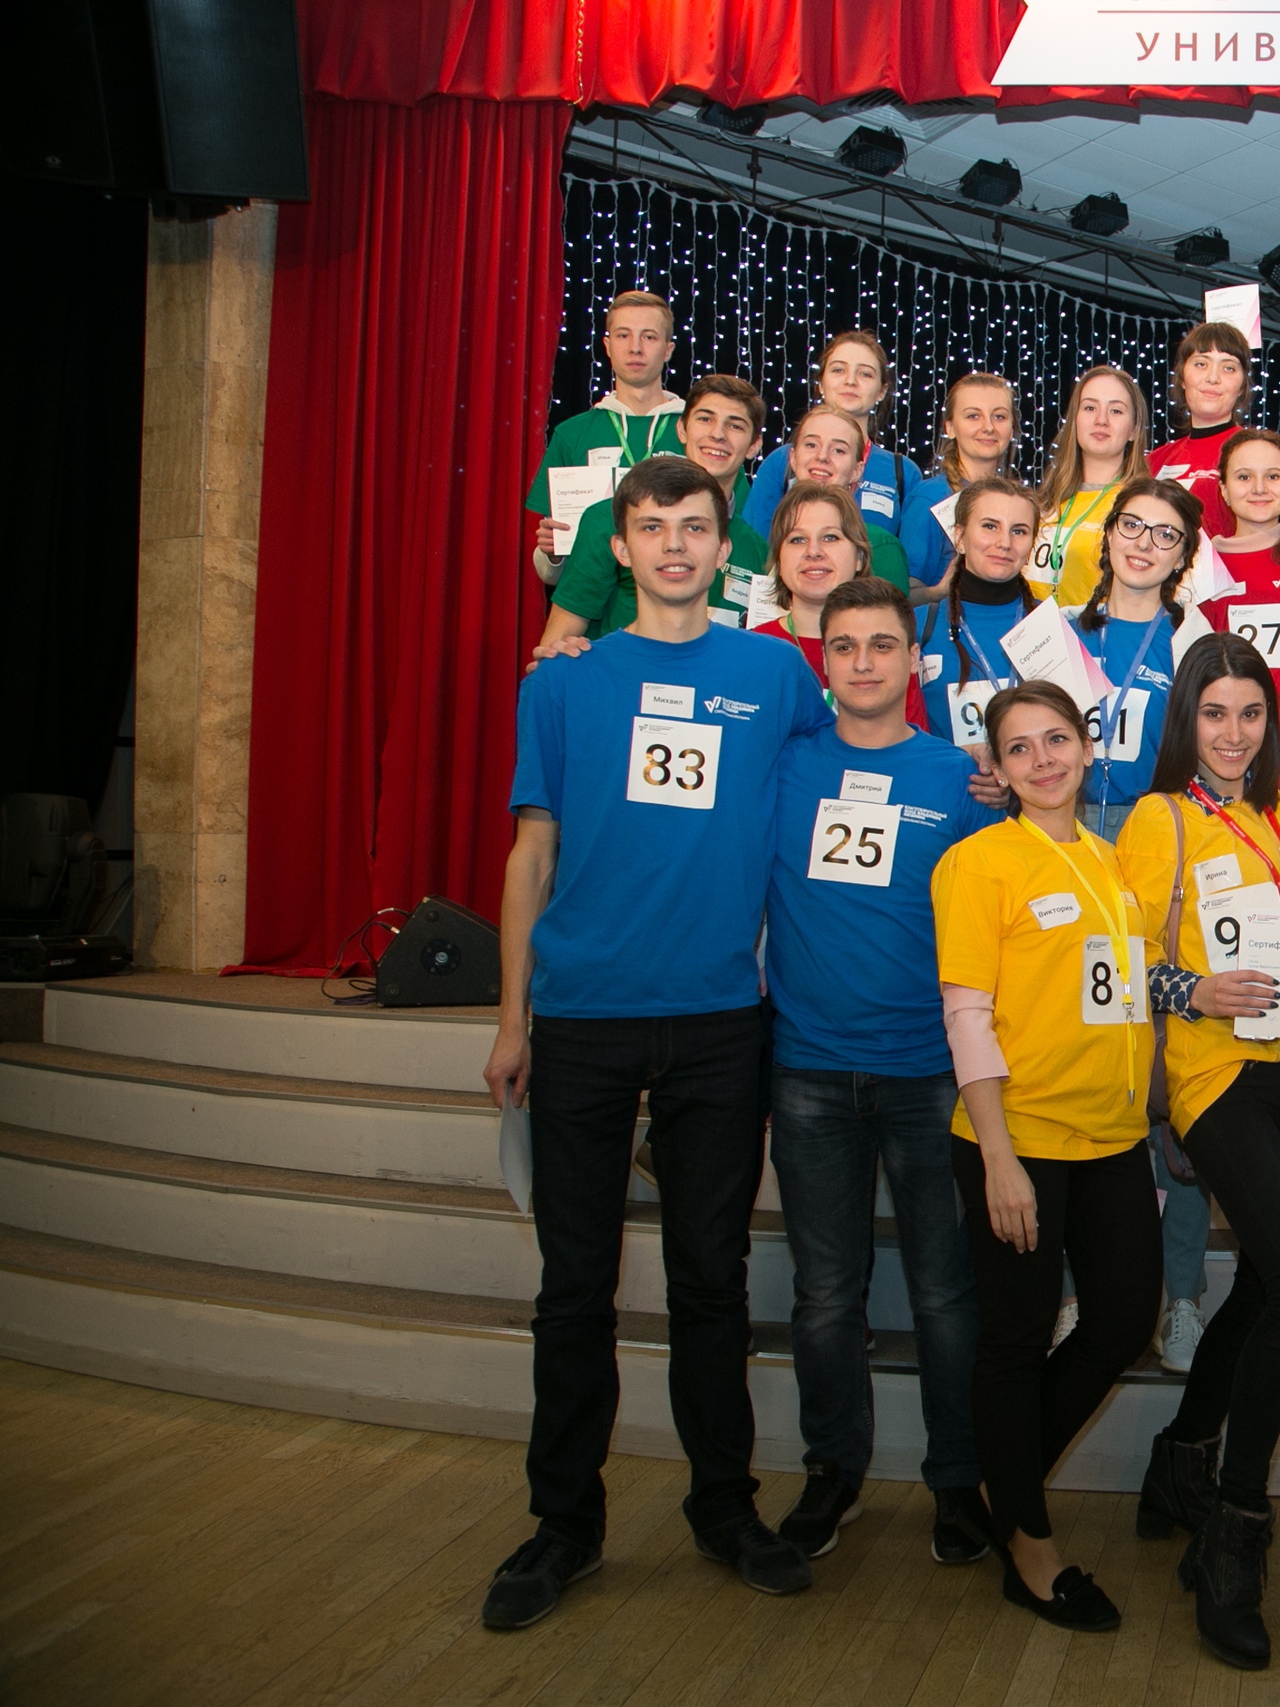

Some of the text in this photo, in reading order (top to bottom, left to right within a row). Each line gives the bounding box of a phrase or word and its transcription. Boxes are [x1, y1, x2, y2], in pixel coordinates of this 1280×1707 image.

[556, 488, 594, 497] Сертификат
[1019, 634, 1052, 665] Сертификат
[653, 695, 683, 706] Михаил
[642, 743, 706, 791] 83
[849, 782, 883, 793] Дмитрий
[822, 822, 885, 868] 25
[1205, 870, 1228, 882] Ирина
[1038, 905, 1074, 919] Виктория
